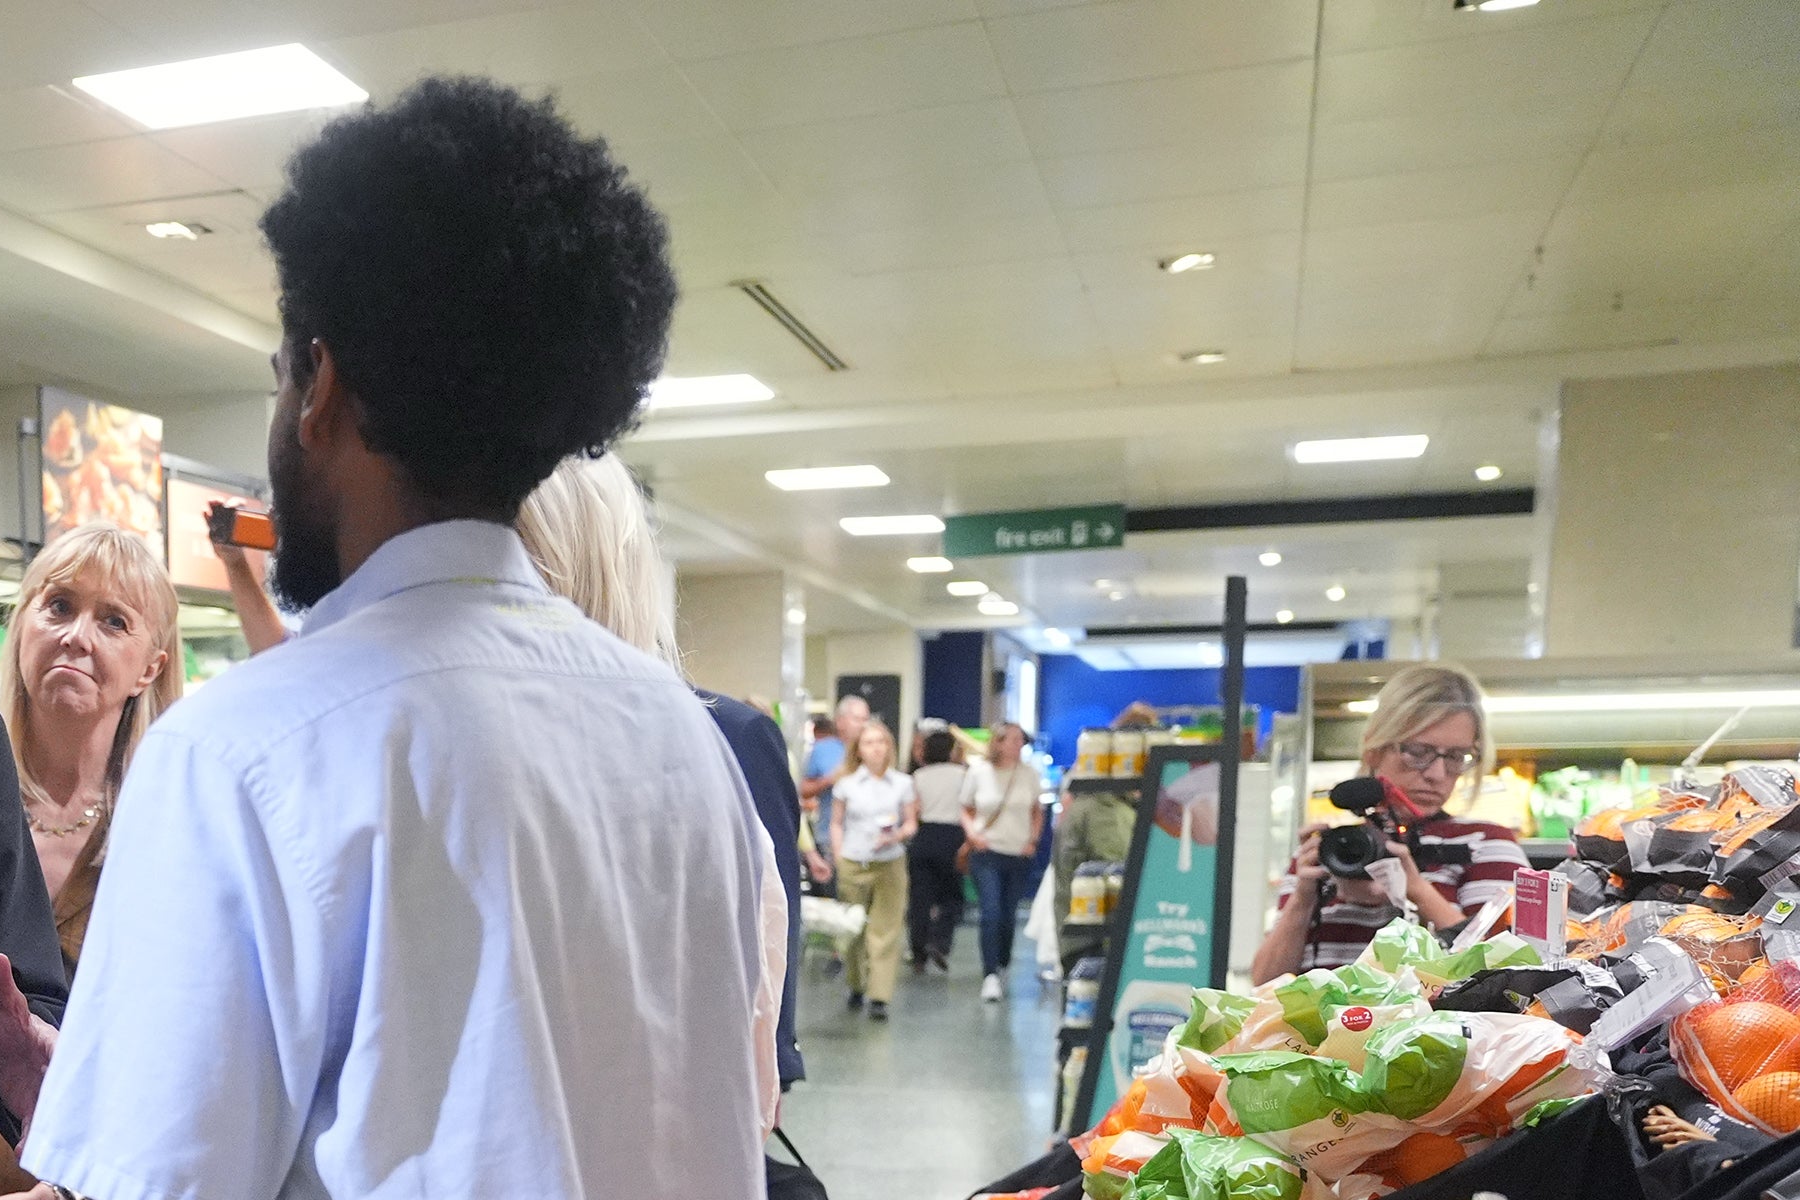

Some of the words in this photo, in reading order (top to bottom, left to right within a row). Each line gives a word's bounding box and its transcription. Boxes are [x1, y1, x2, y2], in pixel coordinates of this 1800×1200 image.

[996, 527, 1026, 549] fire
[1156, 901, 1189, 918] Try
[1363, 1011, 1371, 1020] 2
